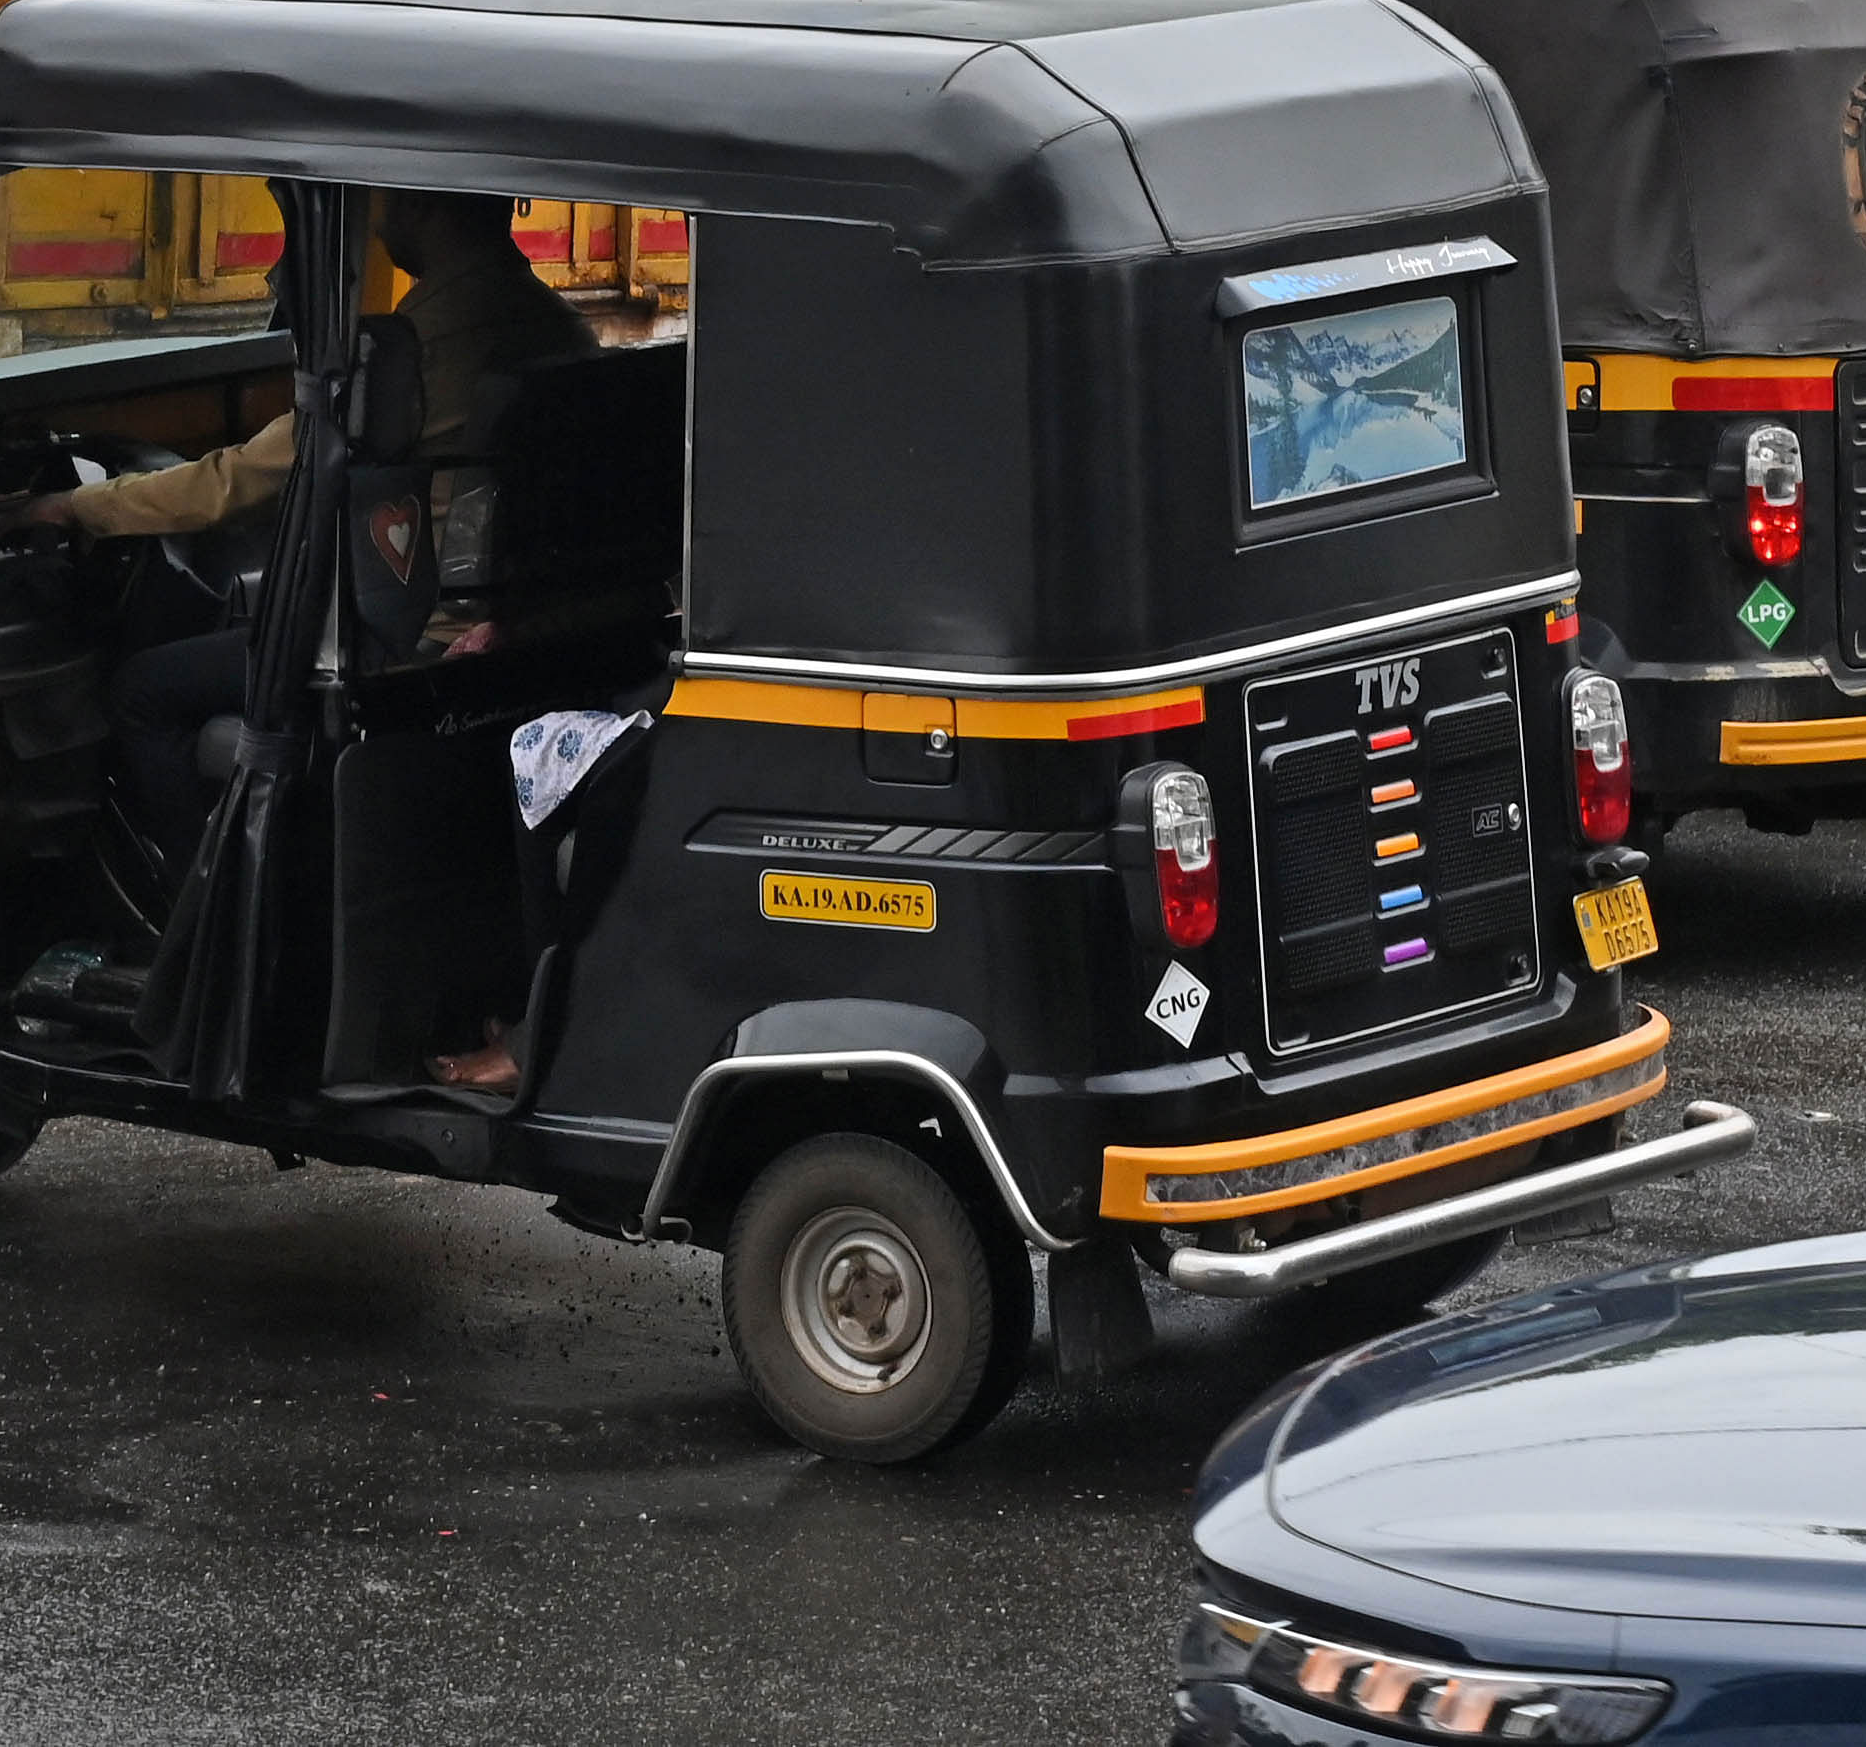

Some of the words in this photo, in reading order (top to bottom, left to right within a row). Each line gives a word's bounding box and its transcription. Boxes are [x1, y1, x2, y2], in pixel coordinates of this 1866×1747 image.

[1386, 250, 1434, 276] Happy
[1747, 603, 1787, 623] LPG
[1355, 657, 1421, 714] TVS
[762, 834, 846, 851] DELUXE
[773, 885, 924, 916] KA.19.AD.6575
[1594, 886, 1642, 927] KA19A
[1603, 920, 1651, 961] D6575
[1156, 986, 1201, 1018] CNG
